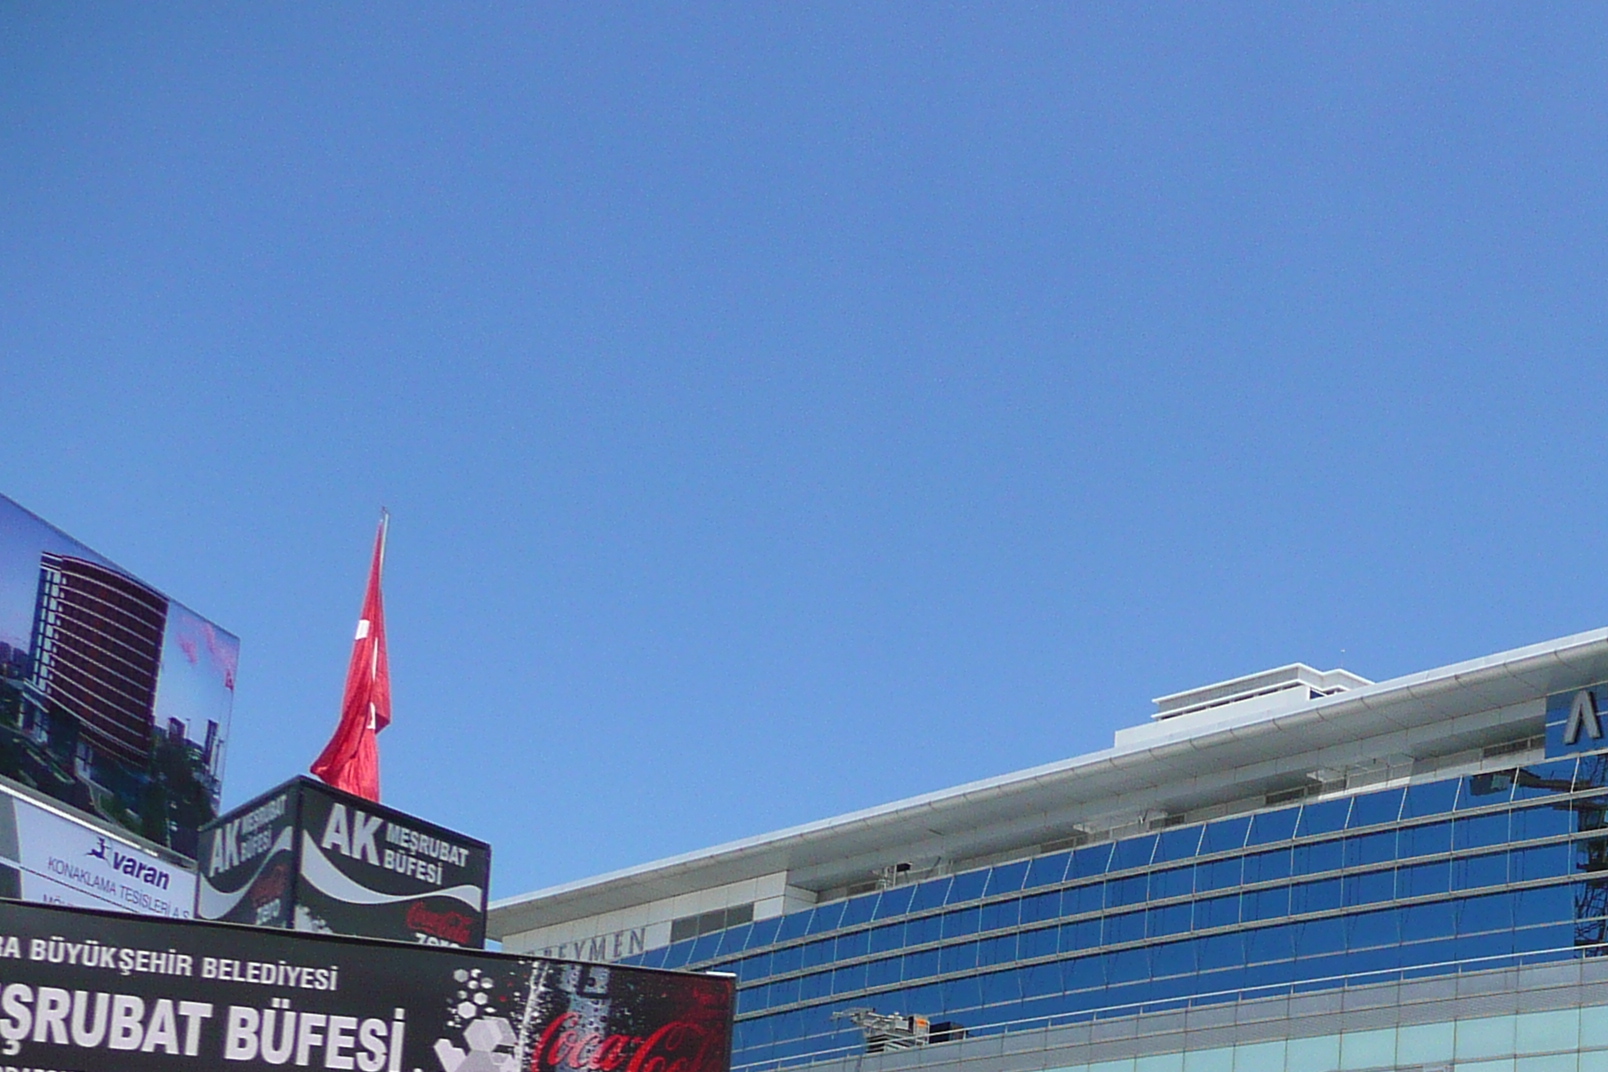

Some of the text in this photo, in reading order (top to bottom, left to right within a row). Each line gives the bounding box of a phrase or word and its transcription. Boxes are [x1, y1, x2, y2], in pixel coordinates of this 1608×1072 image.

[209, 819, 240, 878] AK
[321, 802, 469, 868] AK MEŞRUBAT
[47, 857, 116, 896] KONAKLAMA
[120, 884, 171, 916] TESİSLERİ
[113, 852, 170, 890] varan
[384, 848, 443, 886] BÜFESİ
[30, 935, 193, 978] BÜYÜKŞEHİR
[202, 956, 338, 991] BELEDİYESİ
[0, 982, 213, 1056] ŞRUBAT
